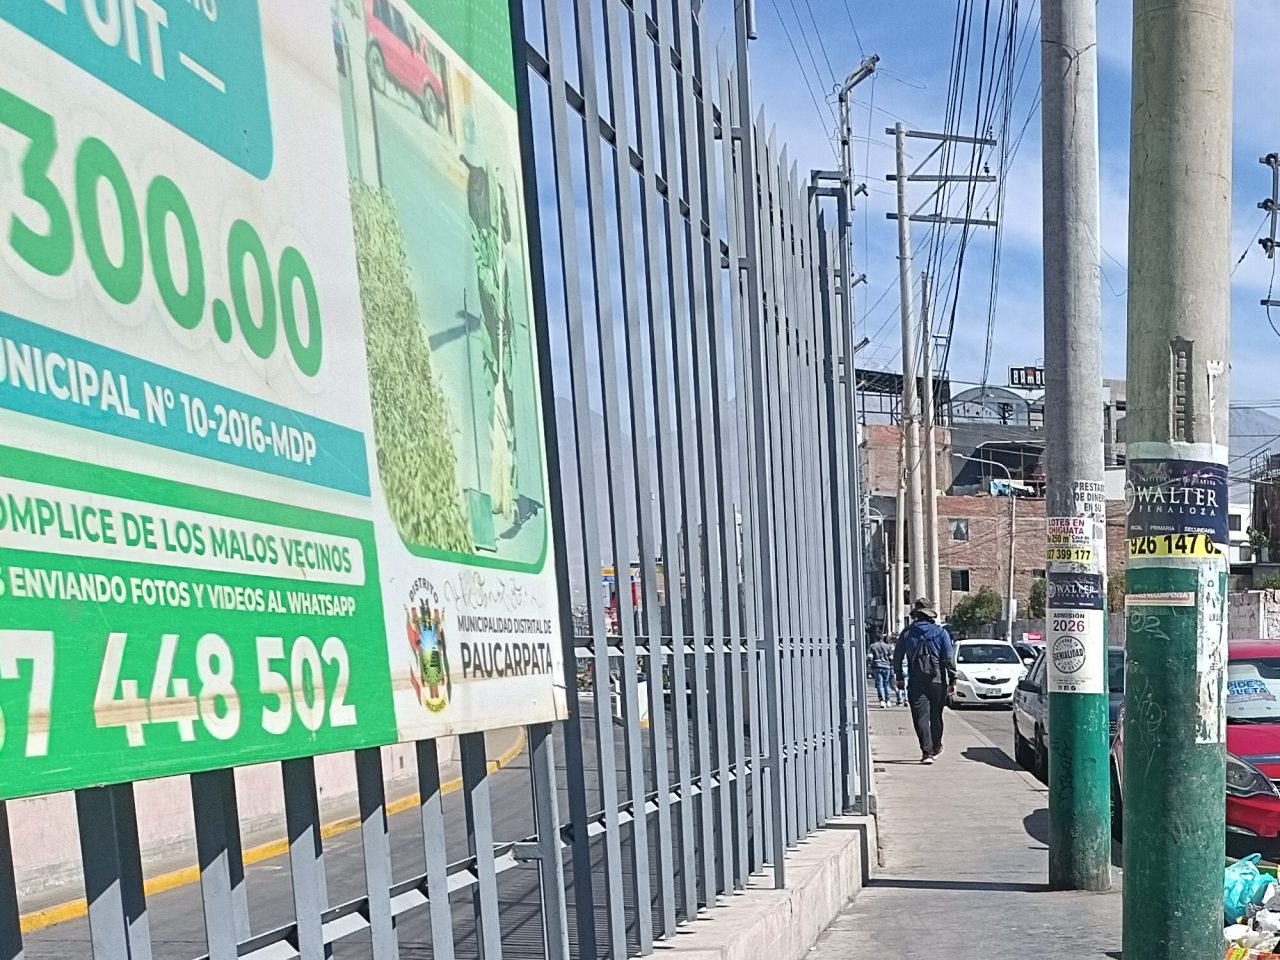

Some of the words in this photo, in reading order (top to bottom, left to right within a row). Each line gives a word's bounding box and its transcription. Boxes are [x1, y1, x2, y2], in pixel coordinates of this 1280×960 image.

[180, 393, 317, 466] 10-2016-MDP
[1137, 486, 1218, 507] WALTER
[1048, 519, 1070, 527] LOTES
[1073, 519, 1085, 527] EN
[1049, 527, 1085, 535] CHIGUATA
[122, 512, 158, 550] DE
[162, 518, 206, 556] LOS
[209, 526, 279, 567] MALOS
[280, 537, 353, 573] VECINOS
[1131, 535, 1157, 554] 926
[1164, 535, 1198, 554] 147
[1057, 549, 1072, 560] 399
[1075, 549, 1091, 560] 177
[9, 567, 126, 604] ENVIANDO
[130, 578, 191, 608] FOTOS
[192, 583, 206, 600] Y
[207, 584, 265, 612] VIDEOS
[268, 591, 287, 613] AL
[287, 591, 356, 617] WHATSAPP
[408, 577, 439, 604] DISTRITO
[457, 615, 513, 633] MUNICIPALIDAD
[514, 618, 543, 634] DISTRITAL
[544, 619, 552, 634] DE
[1053, 620, 1085, 632] 2026
[460, 642, 553, 679] PAUCARPATA
[94, 632, 241, 748] 448
[256, 636, 357, 735] 502
